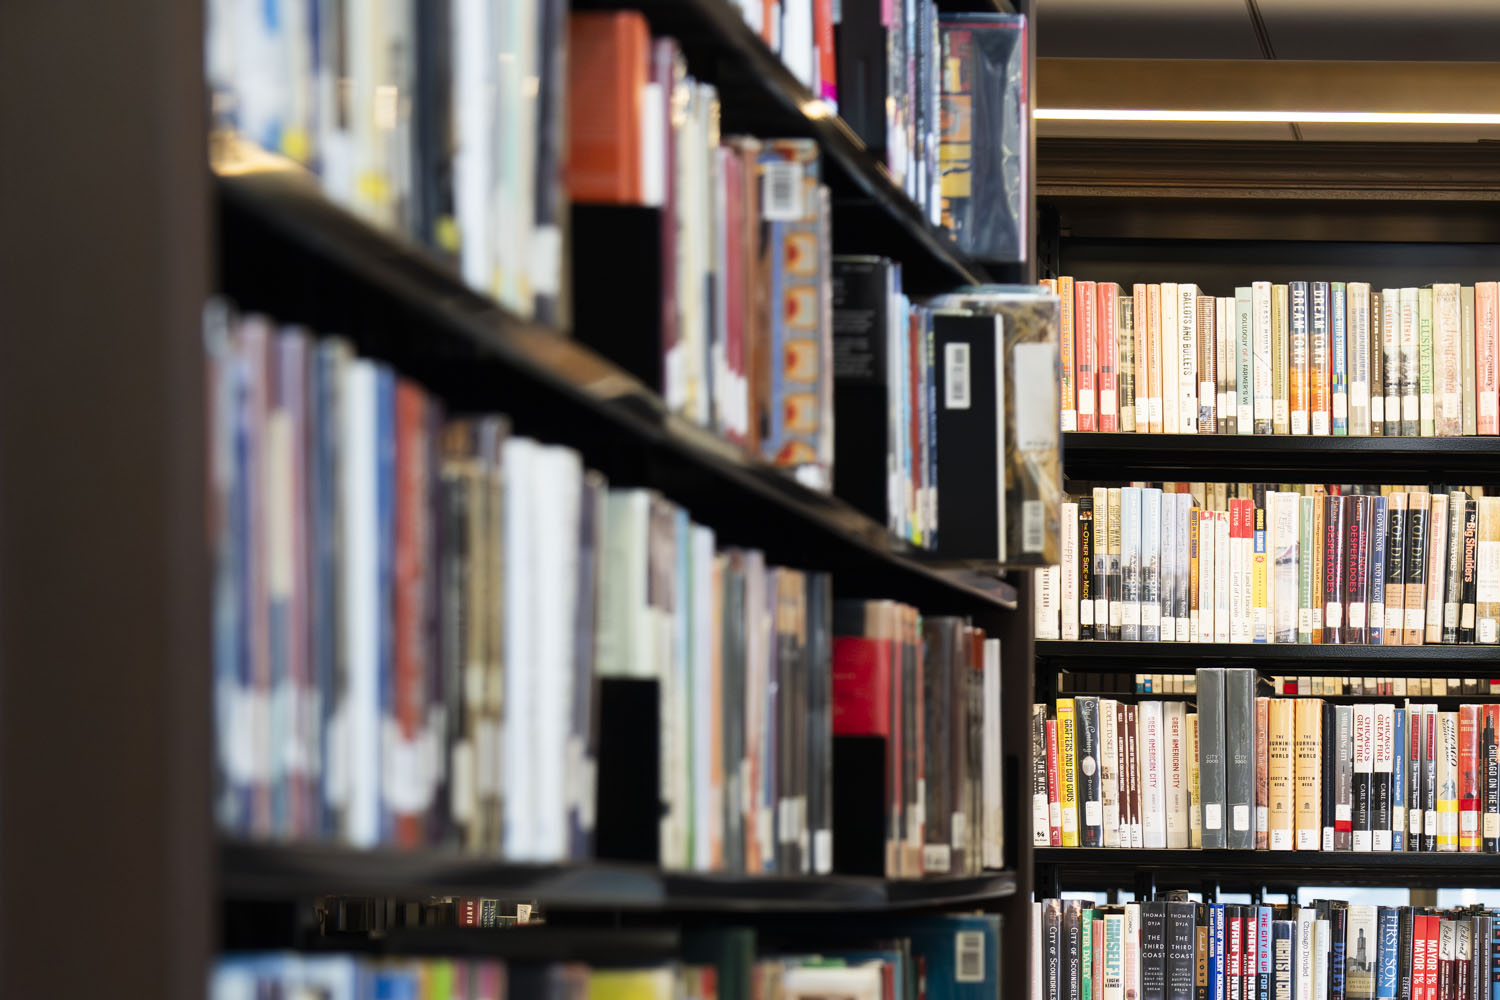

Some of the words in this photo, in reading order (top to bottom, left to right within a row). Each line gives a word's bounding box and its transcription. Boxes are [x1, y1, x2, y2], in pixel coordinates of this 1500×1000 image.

[1183, 292, 1192, 324] BALLOTS
[1293, 290, 1305, 329] DREAM
[1314, 290, 1325, 329] DREAM
[1403, 304, 1411, 342] LEVIATHAN
[1183, 326, 1192, 341] AND
[1385, 305, 1393, 343] LEVIATHAN
[1241, 348, 1248, 356] OF
[1293, 334, 1305, 364] TOWN
[1314, 334, 1325, 364] TOWN
[1421, 319, 1430, 360] ELUSIVE
[1183, 344, 1192, 375] BULLETS
[1375, 513, 1383, 551] GOVERNOR
[1464, 521, 1475, 536] Big
[1326, 525, 1335, 593] DESPERADOES
[1349, 525, 1358, 593] DESPERADOES
[1390, 514, 1402, 579] GOLDEN
[1410, 513, 1423, 579] GOLDEN
[1464, 538, 1474, 582] Shoulders
[1064, 719, 1073, 752] GRAFTERS
[1172, 717, 1180, 737] GREAT
[1065, 753, 1073, 767] AND
[1172, 739, 1180, 772] AMERICAN
[1488, 744, 1497, 776] CHICAGO
[1066, 768, 1074, 783] GOO
[1172, 774, 1180, 789] CITY
[1488, 778, 1497, 789] ON
[1066, 784, 1074, 802] GOOS
[1488, 791, 1497, 805] THE
[1049, 927, 1057, 944] CITY
[1083, 916, 1091, 947] AFTER
[1260, 913, 1268, 928] THE
[1302, 921, 1310, 950] Chicago
[1385, 915, 1398, 952] FIRST
[1050, 947, 1056, 955] OF
[1106, 919, 1120, 977] HIMSELF!
[1231, 920, 1239, 952] WHEN
[1260, 930, 1268, 949] CITY
[1083, 949, 1091, 978] DALEY
[1231, 953, 1239, 975] THE
[1260, 951, 1268, 959] IS
[1260, 960, 1268, 972] UP
[1333, 942, 1345, 992] DALEY
[1414, 939, 1425, 971] MAYOR
[1427, 939, 1437, 971] MAYOR
[1260, 974, 1268, 989] FOR
[1384, 957, 1396, 988] SON
[1414, 972, 1424, 984] 1%
[1426, 972, 1436, 984] 1%
